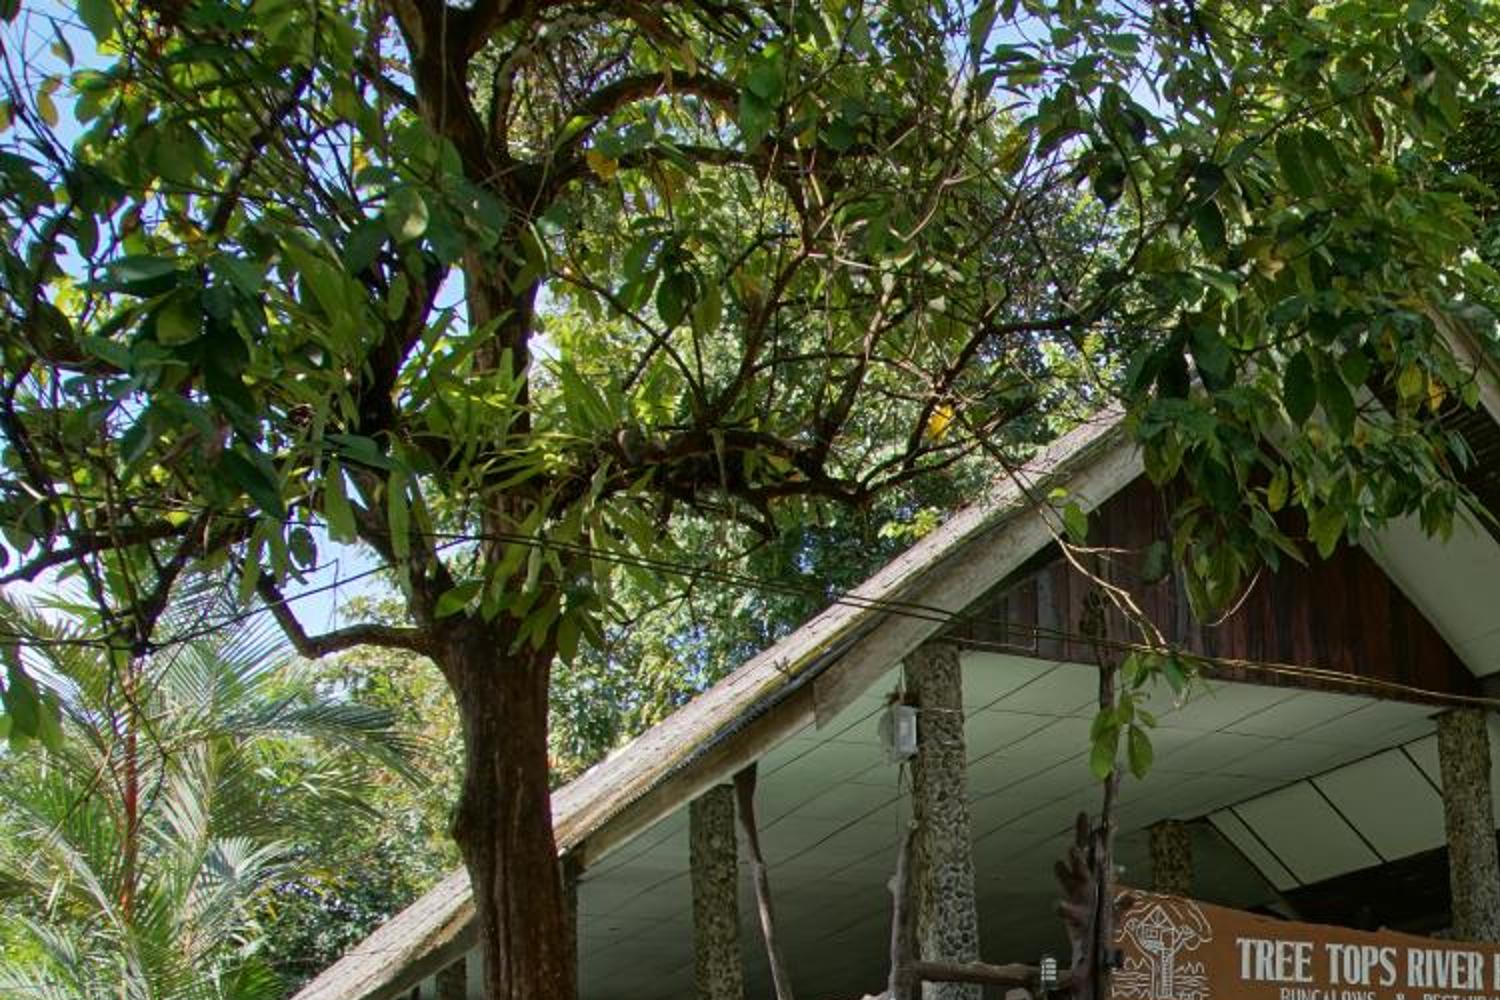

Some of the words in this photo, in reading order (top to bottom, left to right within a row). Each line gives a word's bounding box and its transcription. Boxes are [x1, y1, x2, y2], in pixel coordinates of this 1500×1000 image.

[1236, 936, 1313, 983] TREE
[1326, 942, 1396, 985] TOPS
[1407, 948, 1483, 990] RIVER
